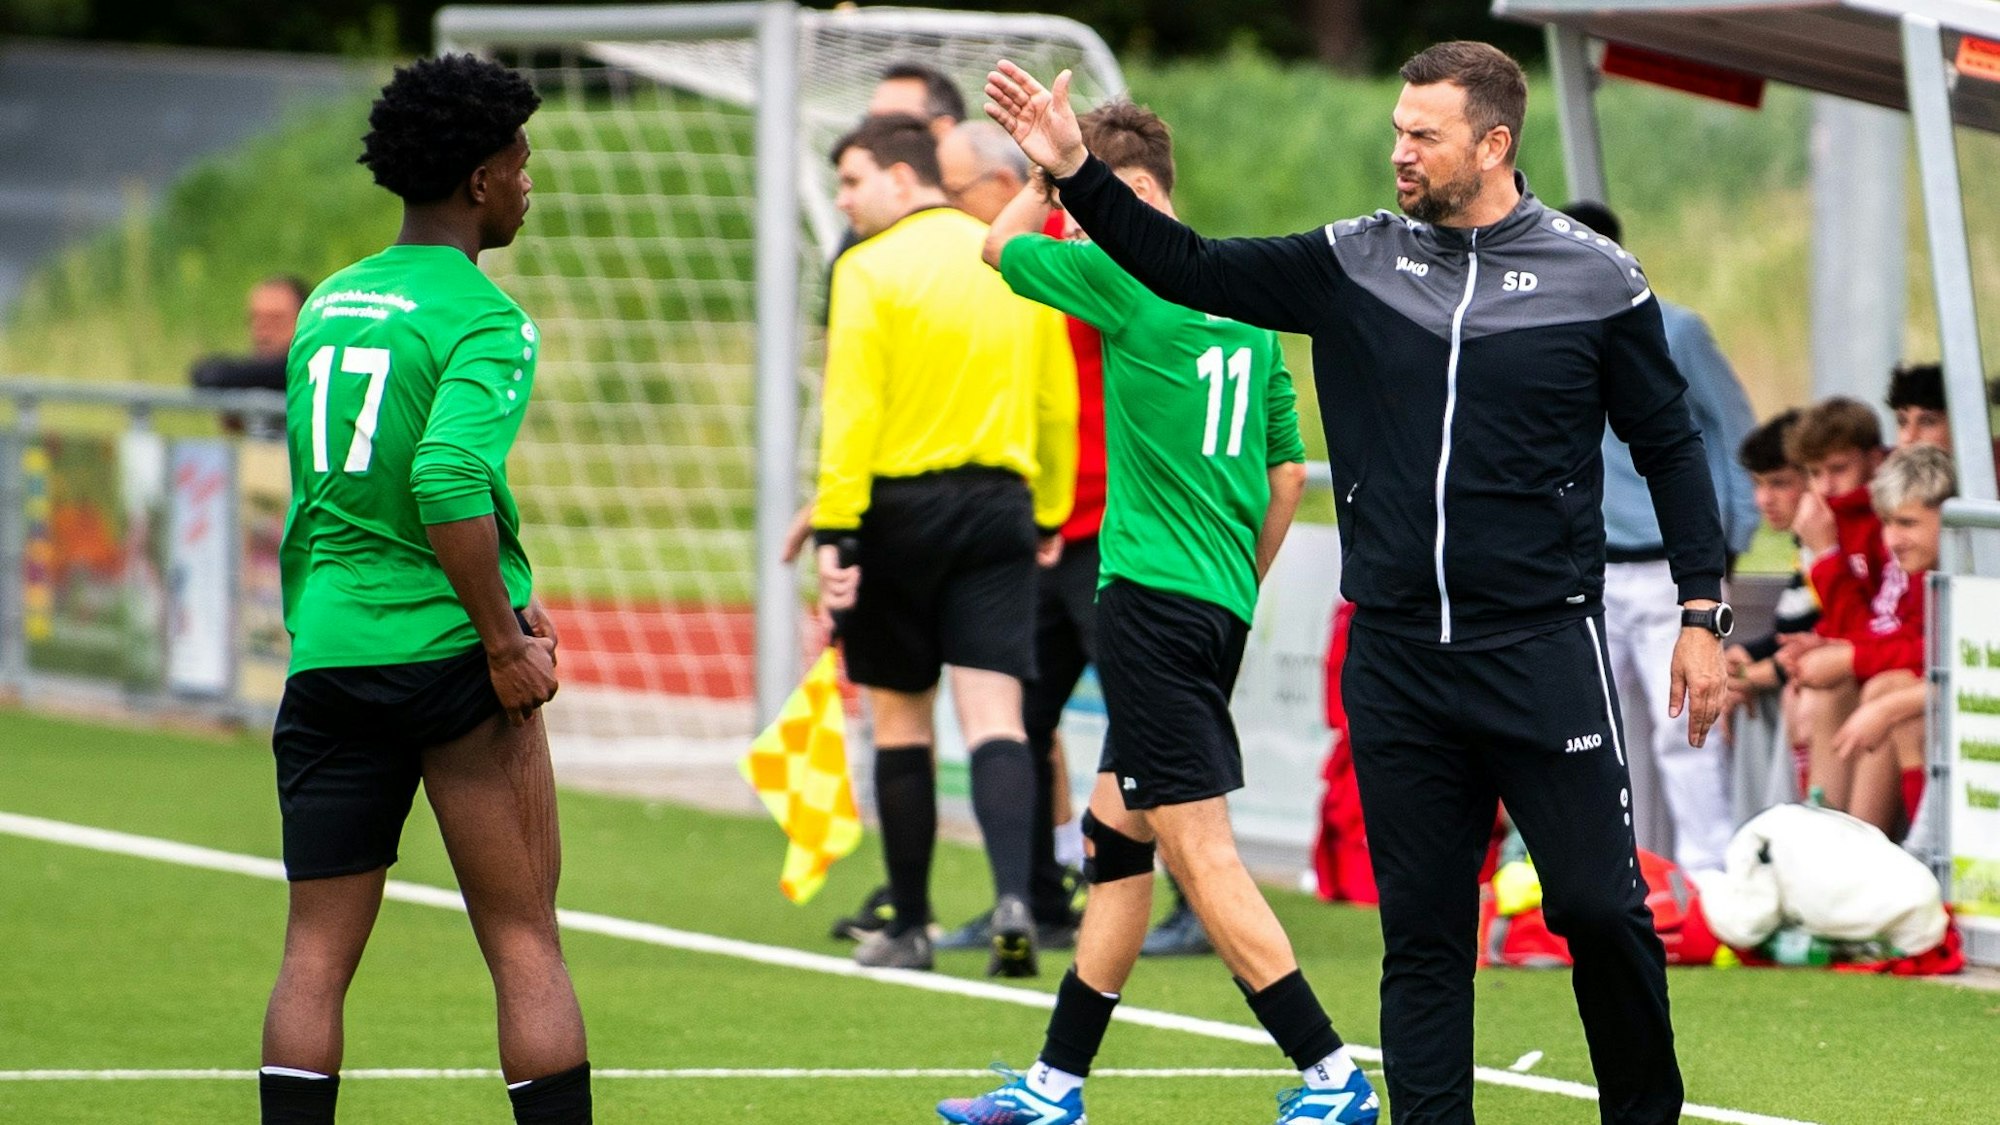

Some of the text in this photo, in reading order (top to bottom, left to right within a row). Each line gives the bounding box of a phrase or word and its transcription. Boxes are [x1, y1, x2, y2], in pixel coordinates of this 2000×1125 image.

[1395, 255, 1429, 277] JAKO
[1502, 270, 1539, 292] SD
[307, 345, 390, 472] 17
[1196, 346, 1252, 457] 11
[1565, 733, 1602, 753] JAKO
